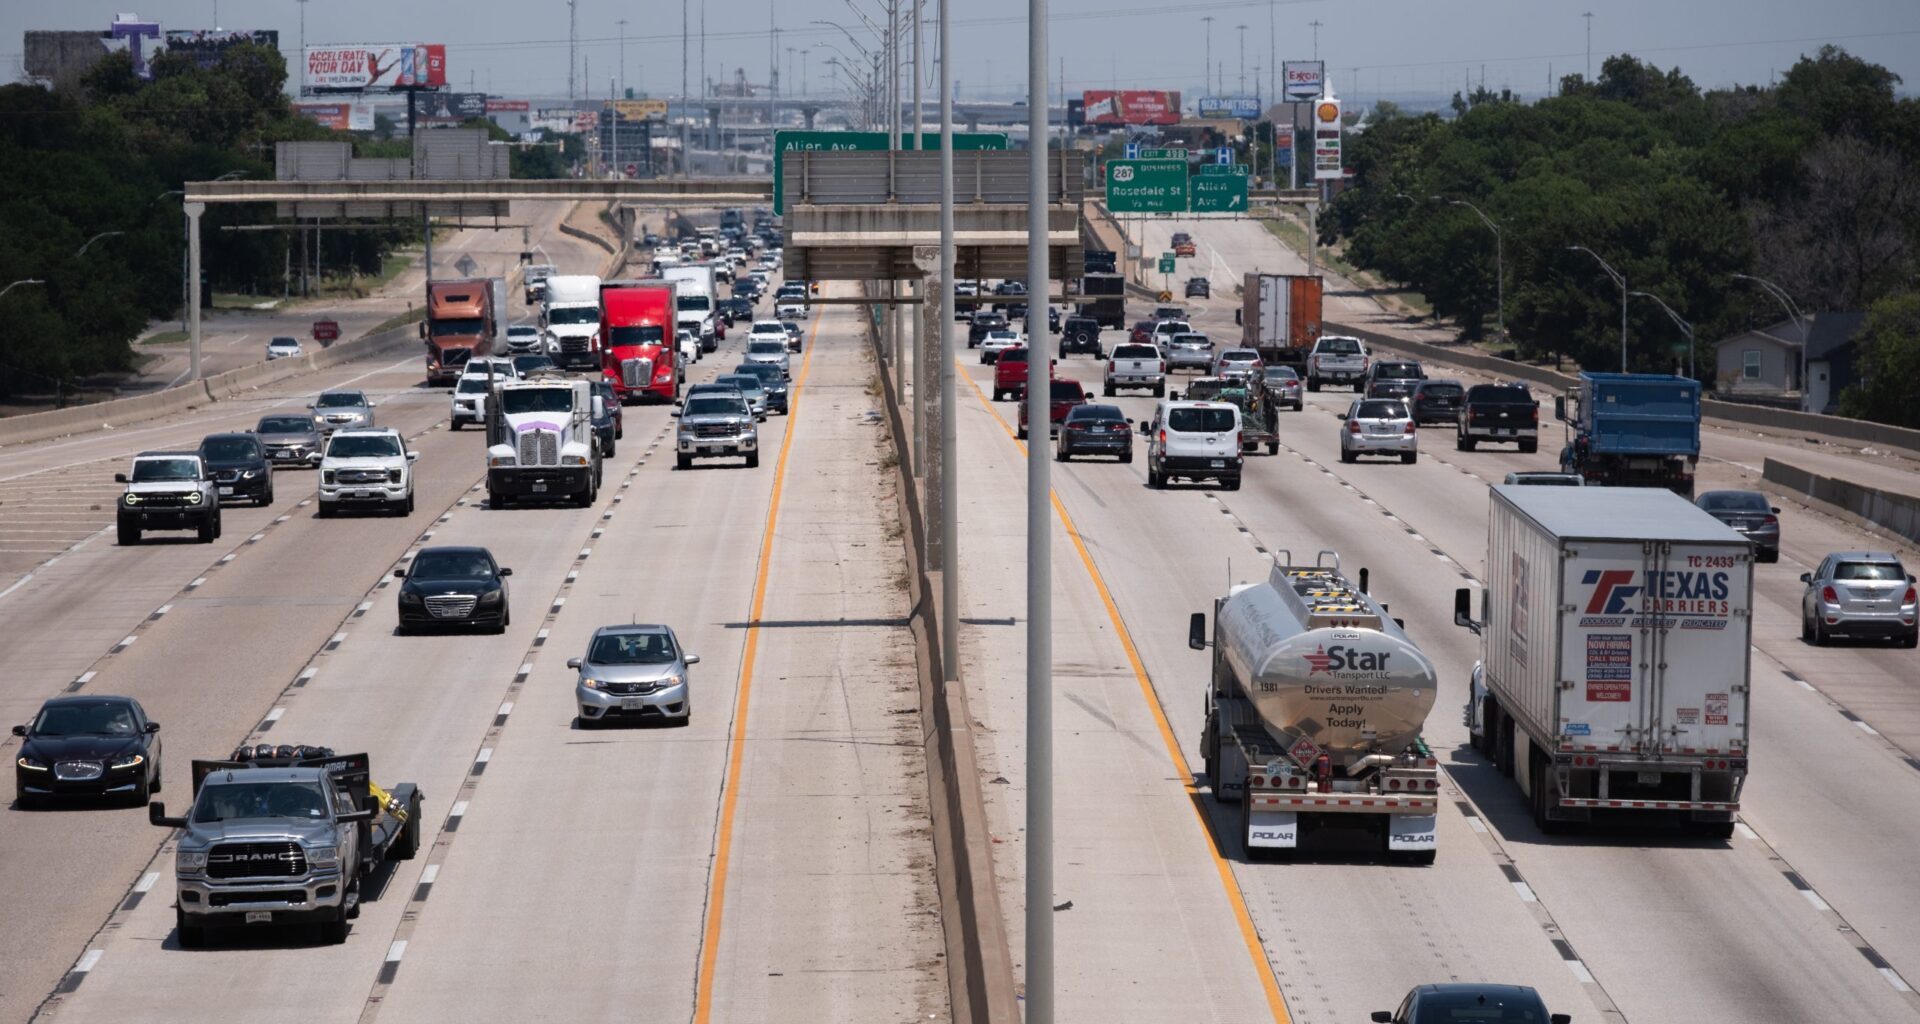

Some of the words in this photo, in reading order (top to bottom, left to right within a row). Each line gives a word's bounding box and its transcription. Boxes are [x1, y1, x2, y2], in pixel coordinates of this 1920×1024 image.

[309, 50, 366, 61] ACCELERATE
[308, 62, 337, 74] YOUR
[340, 61, 365, 73] DAY
[1289, 71, 1318, 82] Exxon
[1201, 101, 1218, 110] SIZE
[1220, 100, 1258, 110] MATTERS
[1165, 149, 1185, 158] 49B
[1114, 168, 1133, 178] 287
[1140, 164, 1181, 172] BUSINESS
[1113, 187, 1165, 196] Rosedale
[1170, 187, 1181, 196] St
[1197, 197, 1217, 206] Ave
[1688, 556, 1702, 567] TC
[1706, 556, 1734, 568] 2433
[1644, 571, 1729, 600] TEXAS
[1642, 600, 1729, 613] CARRIERS
[1588, 640, 1605, 649] NOW
[1606, 640, 1630, 649] HIRING
[1327, 645, 1391, 671] Star
[1332, 671, 1374, 680] Transport
[1376, 671, 1391, 680] LLC
[1261, 682, 1278, 692] 1981
[1304, 685, 1342, 694] Drivers
[1345, 685, 1388, 695] Wanted!
[1329, 703, 1364, 715] Apply
[1326, 717, 1366, 729] Today!
[1252, 831, 1294, 840] POLAR
[1392, 834, 1435, 843] POLAR
[236, 853, 276, 861] RAM
